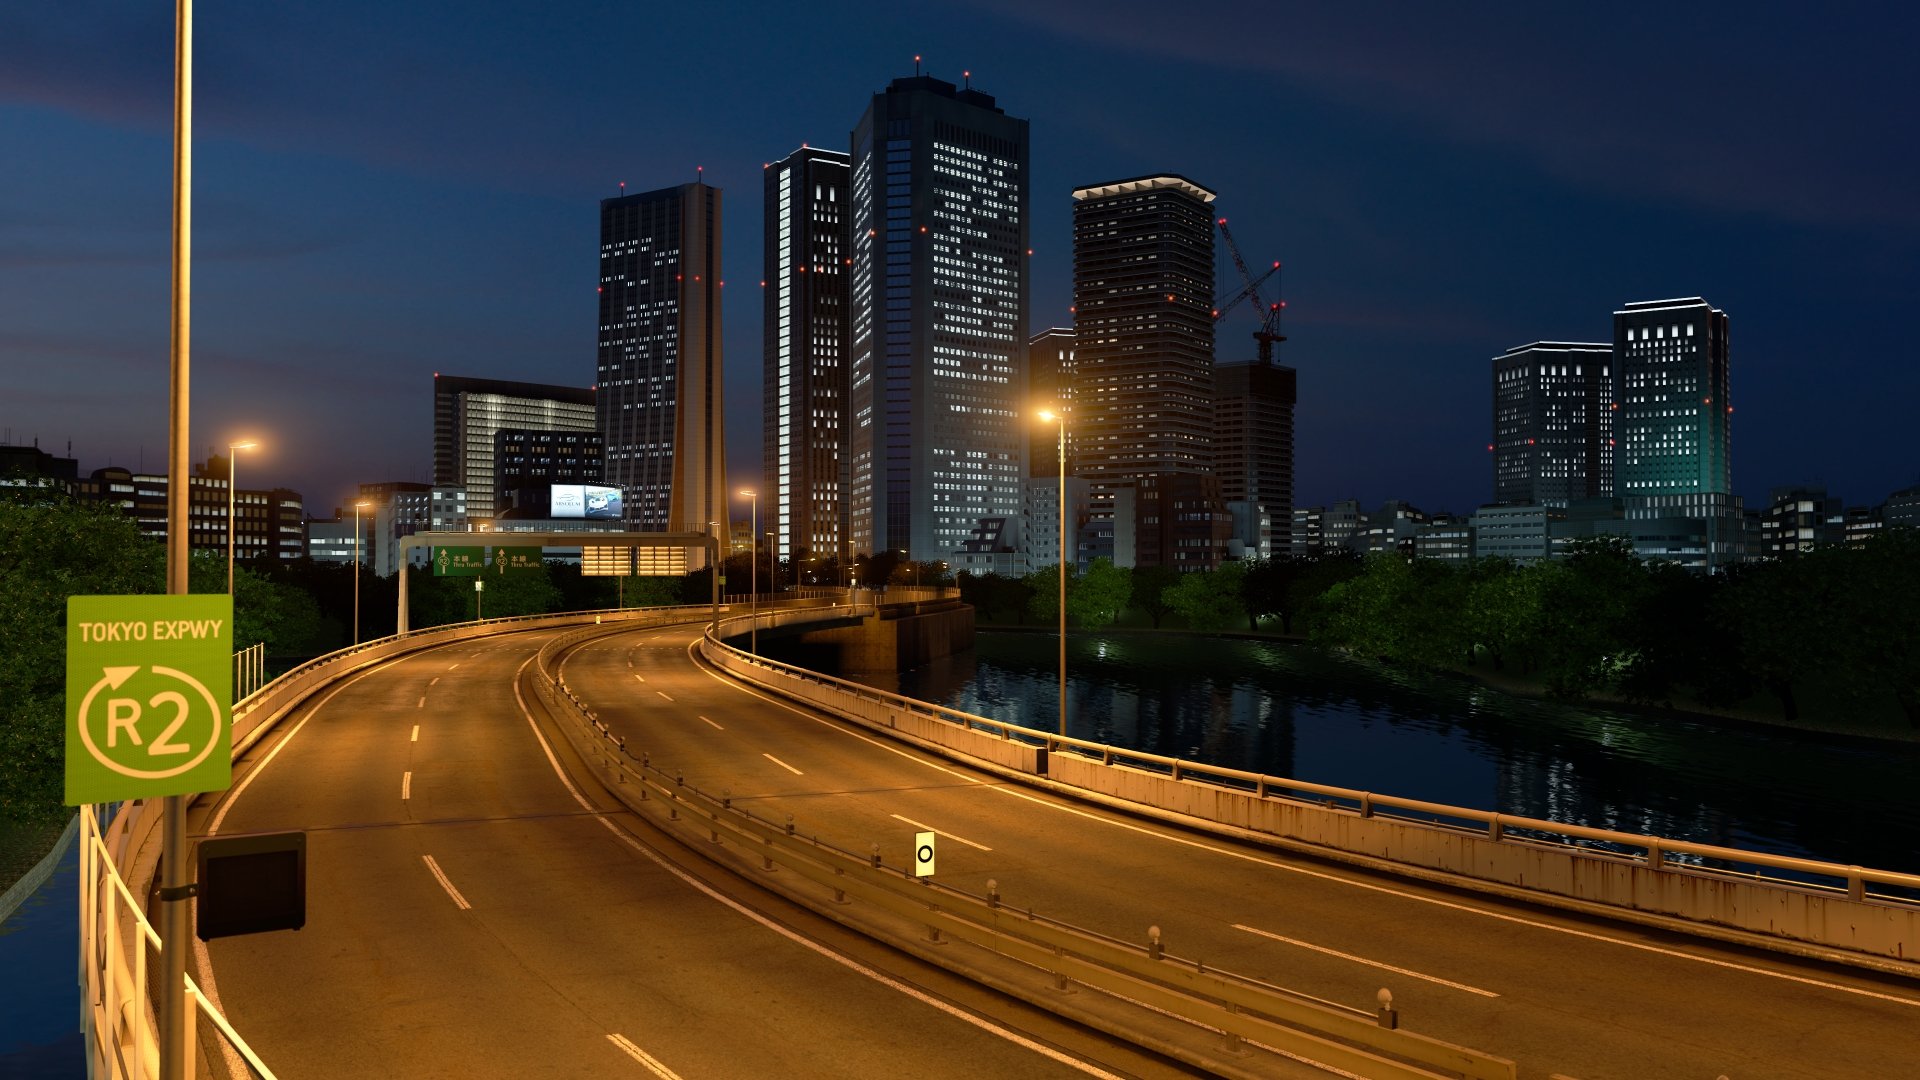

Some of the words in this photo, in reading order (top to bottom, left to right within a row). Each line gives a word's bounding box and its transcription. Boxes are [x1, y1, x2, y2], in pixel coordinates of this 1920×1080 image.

[79, 621, 147, 642] TOKYO
[153, 619, 223, 641] EXPWY
[107, 691, 190, 756] R2
